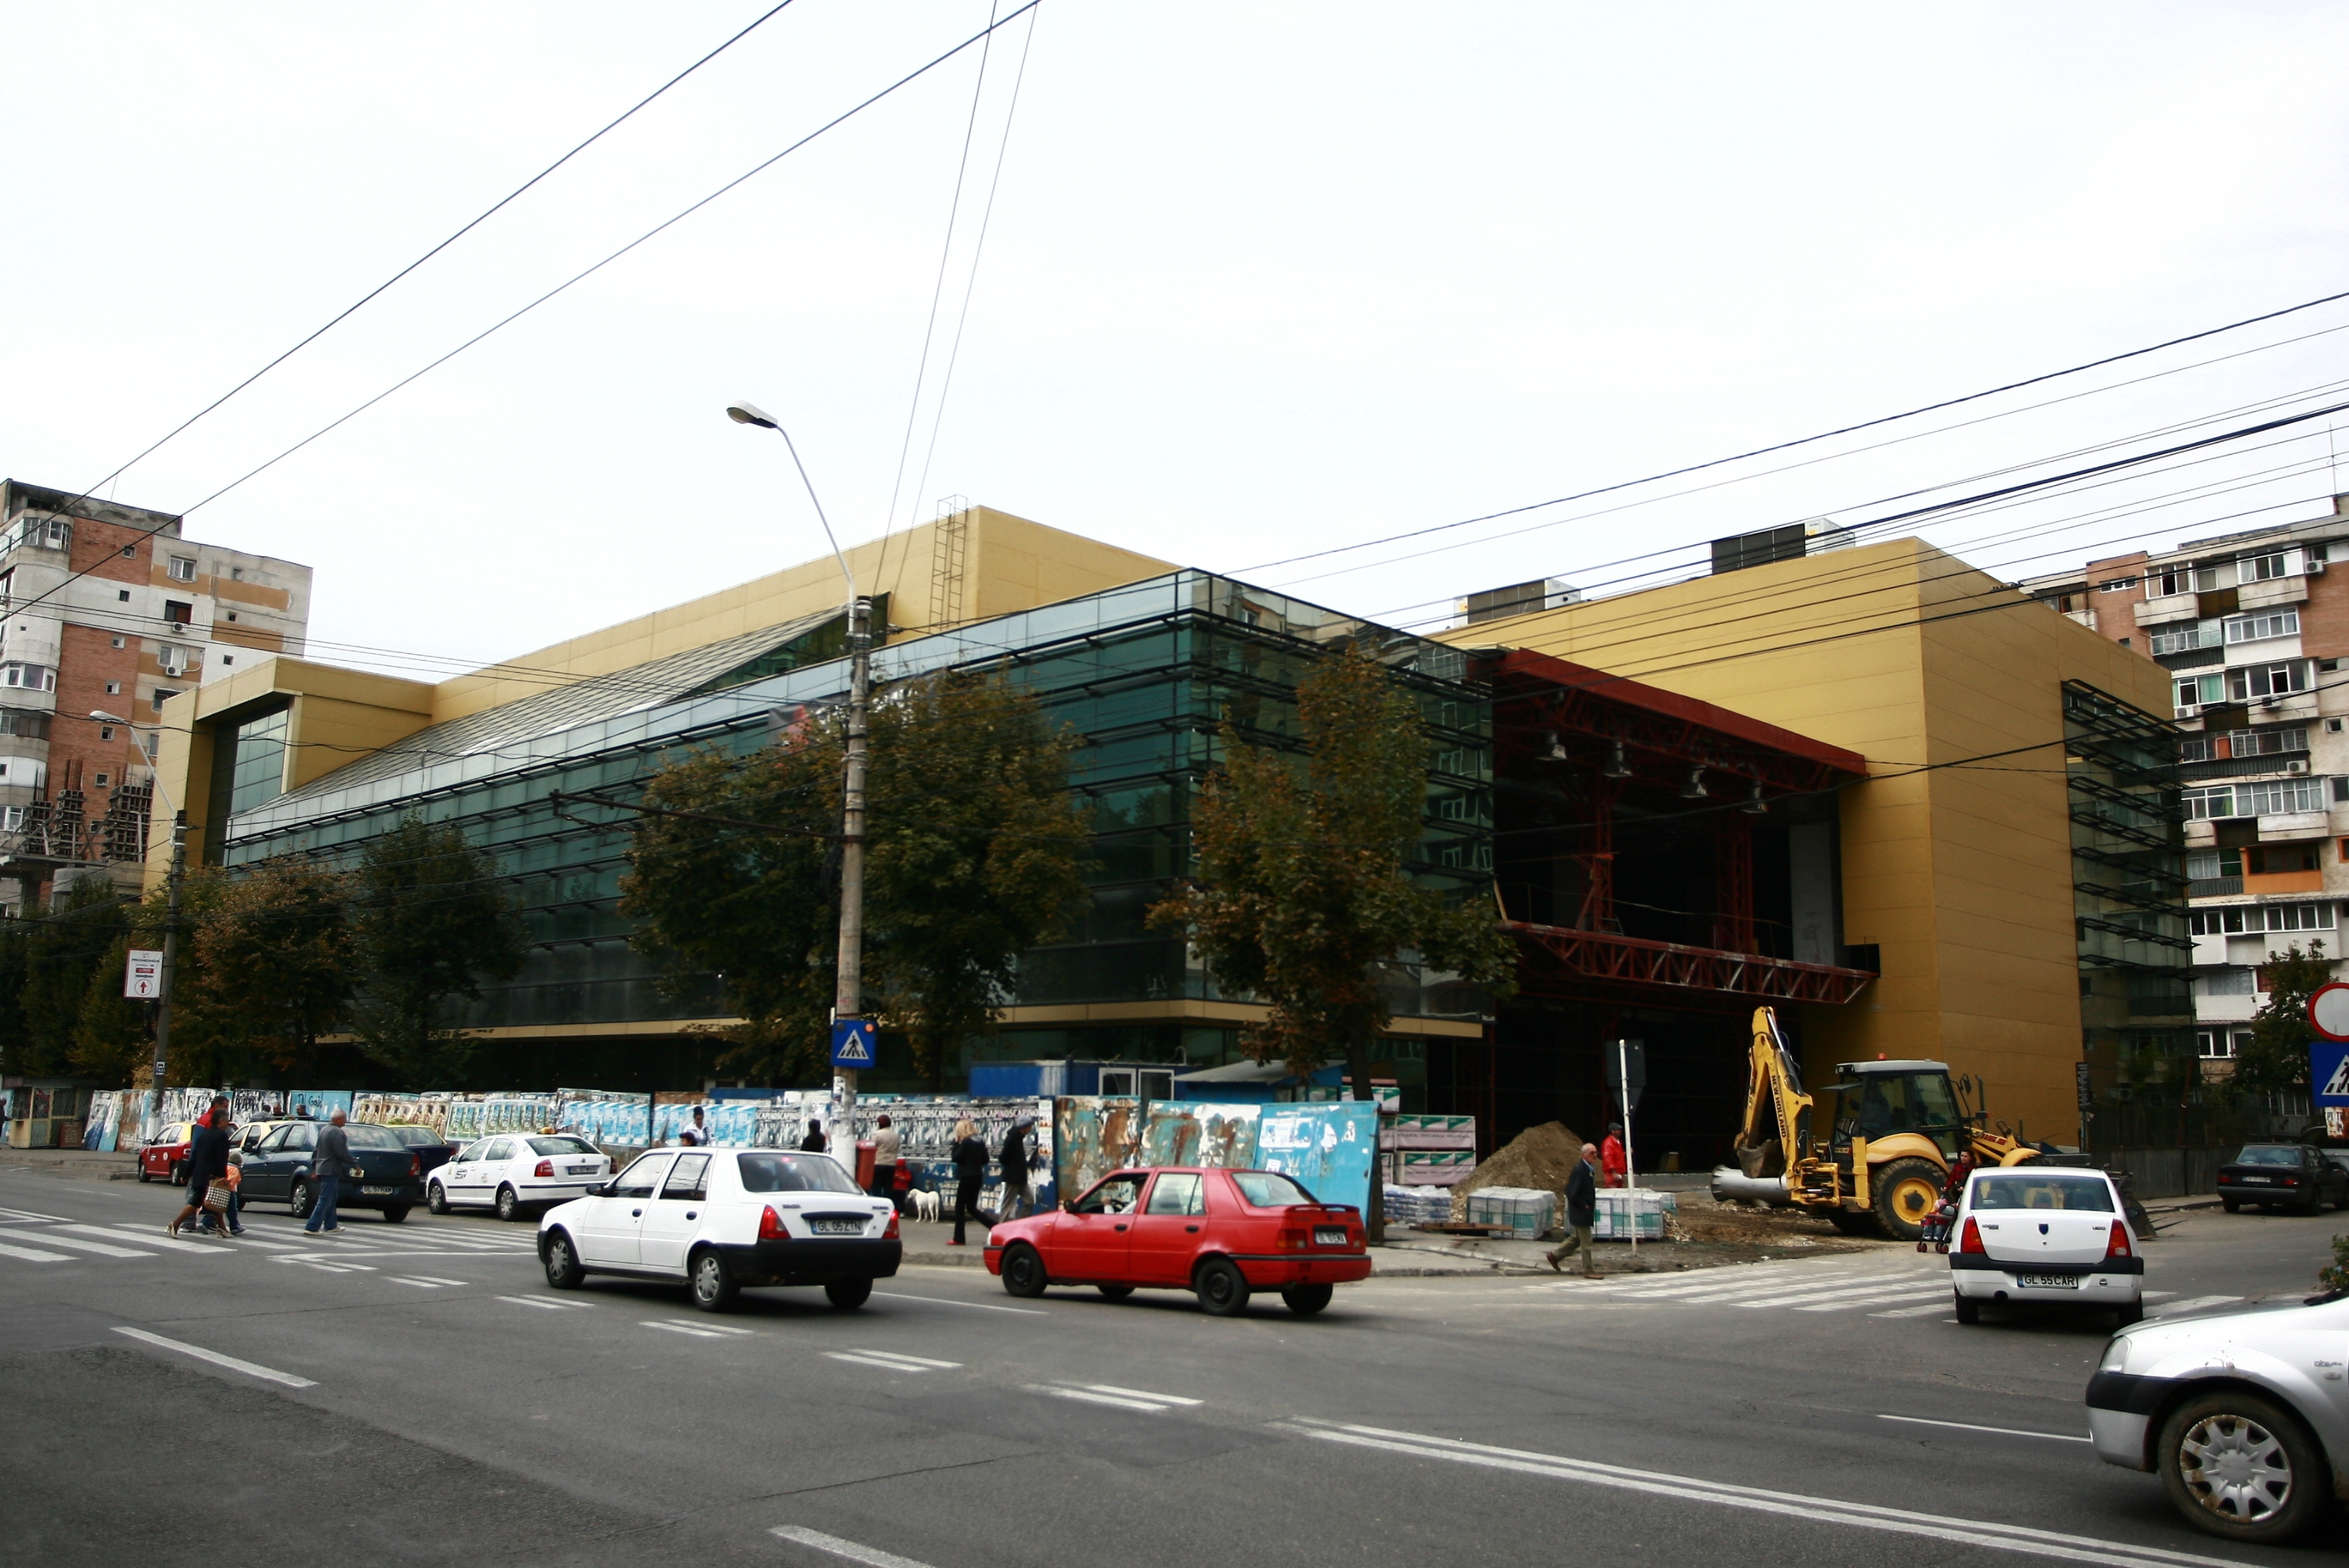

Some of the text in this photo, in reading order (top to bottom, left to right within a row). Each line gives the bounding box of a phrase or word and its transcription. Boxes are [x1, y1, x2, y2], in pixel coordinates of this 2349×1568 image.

[1771, 1075, 1787, 1138] NEW HOLLAND
[981, 1109, 1008, 1118] SCAPINO
[817, 1221, 829, 1231] GL
[2024, 1274, 2075, 1286] GL 55CAR
